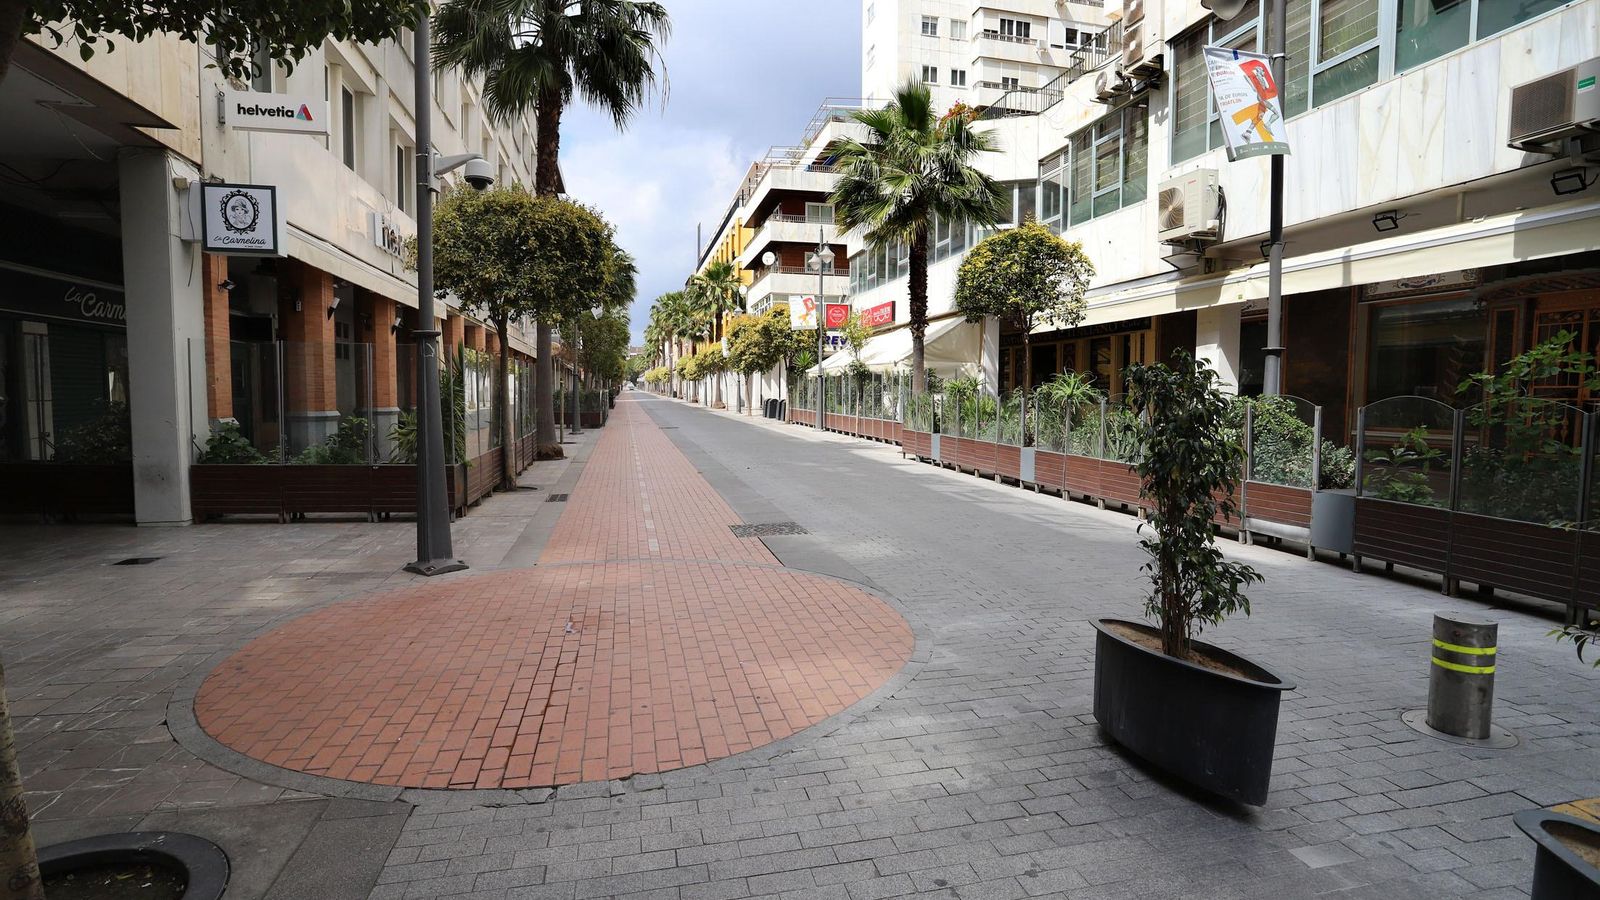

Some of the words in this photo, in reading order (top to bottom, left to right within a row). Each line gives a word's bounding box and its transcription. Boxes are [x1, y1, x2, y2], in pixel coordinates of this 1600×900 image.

[237, 103, 294, 118] helvetia
[222, 235, 266, 245] Carmelina
[64, 286, 81, 302] La
